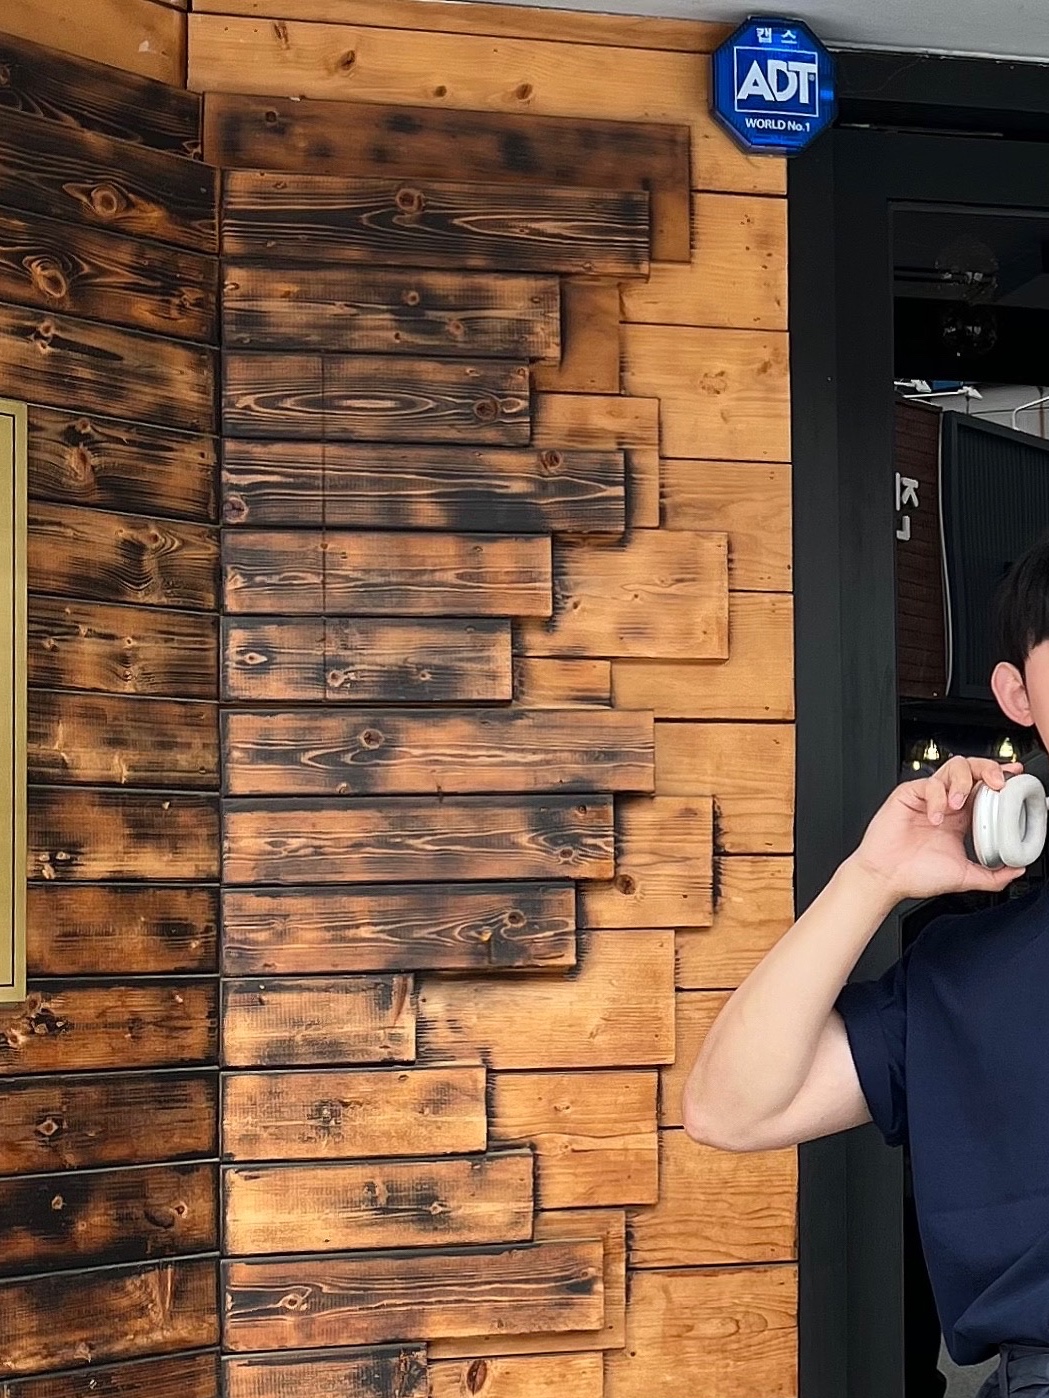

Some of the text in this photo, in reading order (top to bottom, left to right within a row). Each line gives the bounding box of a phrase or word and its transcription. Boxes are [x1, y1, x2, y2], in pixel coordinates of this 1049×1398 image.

[737, 59, 817, 105] ADT
[745, 117, 810, 132] WORLD No.1
